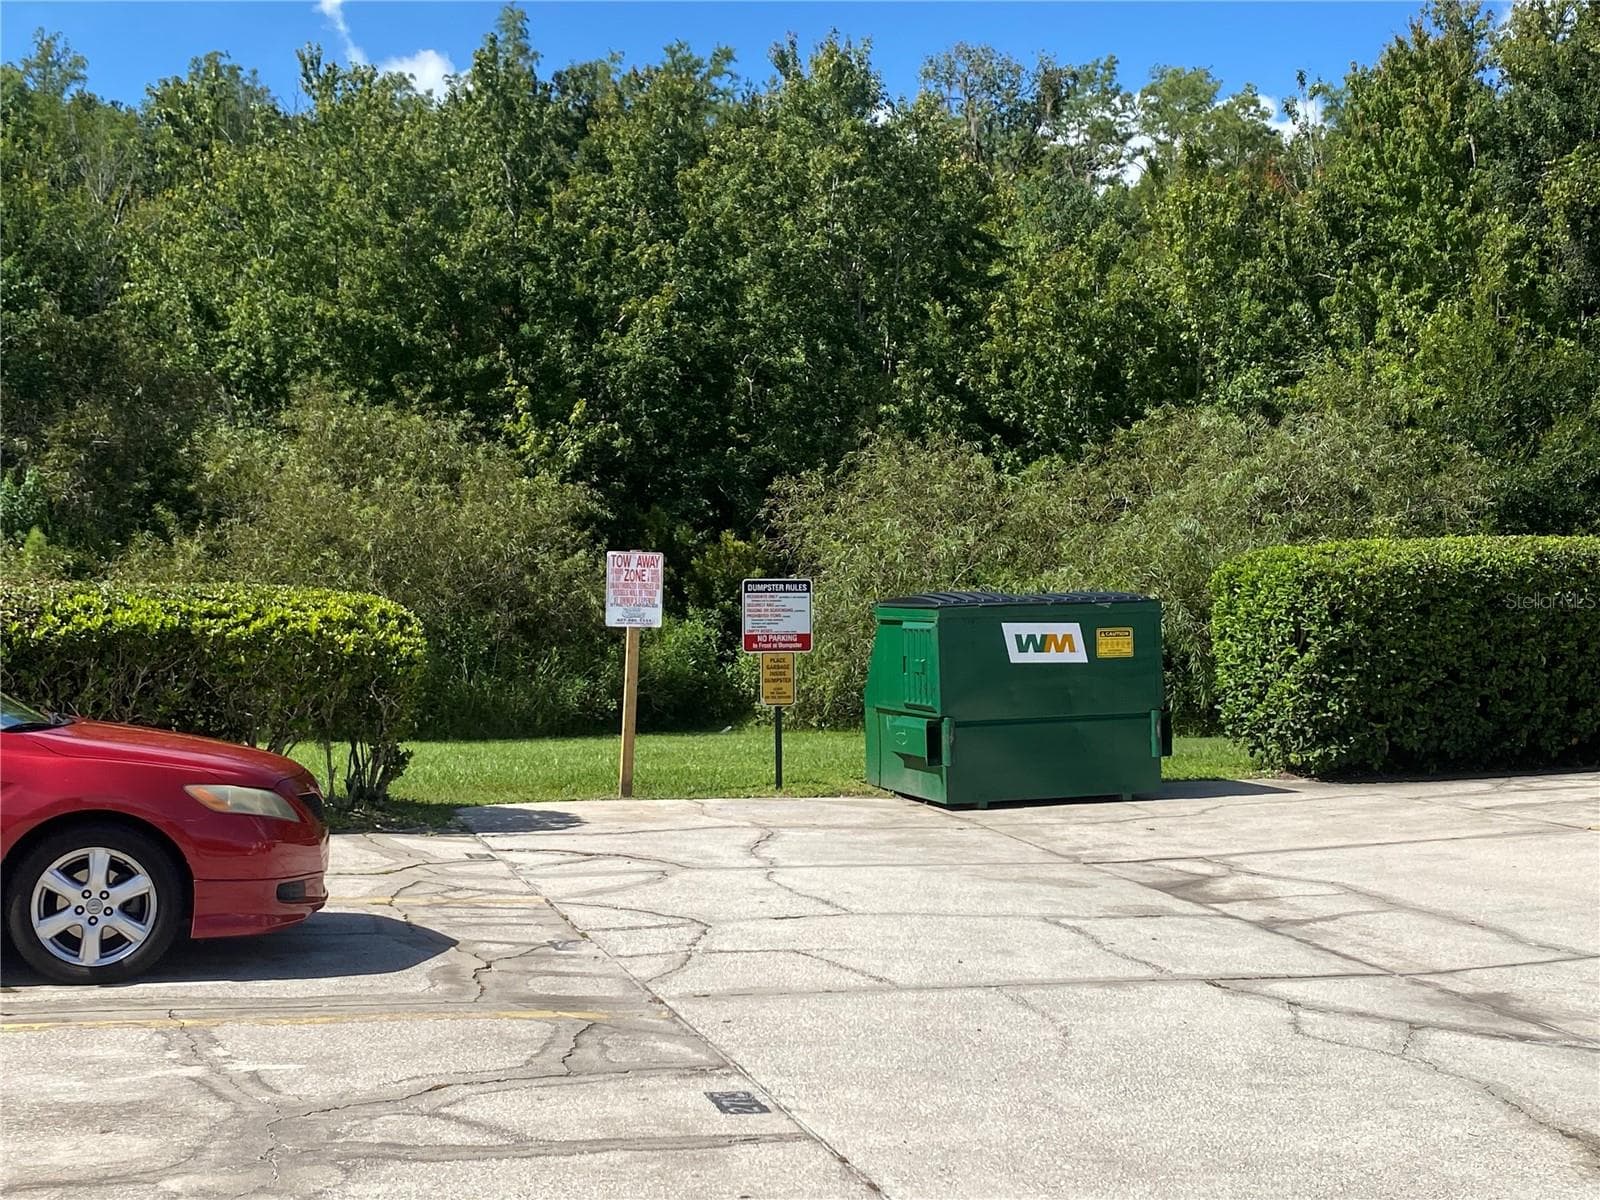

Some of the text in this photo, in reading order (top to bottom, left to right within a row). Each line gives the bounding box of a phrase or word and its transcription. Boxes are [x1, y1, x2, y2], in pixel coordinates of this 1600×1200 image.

[611, 555, 661, 569] TOW AWAY
[623, 568, 647, 582] ZONE
[747, 583, 808, 592] DUMPSTER RULES
[757, 634, 798, 643] NO PARKING
[1014, 633, 1076, 654] WM
